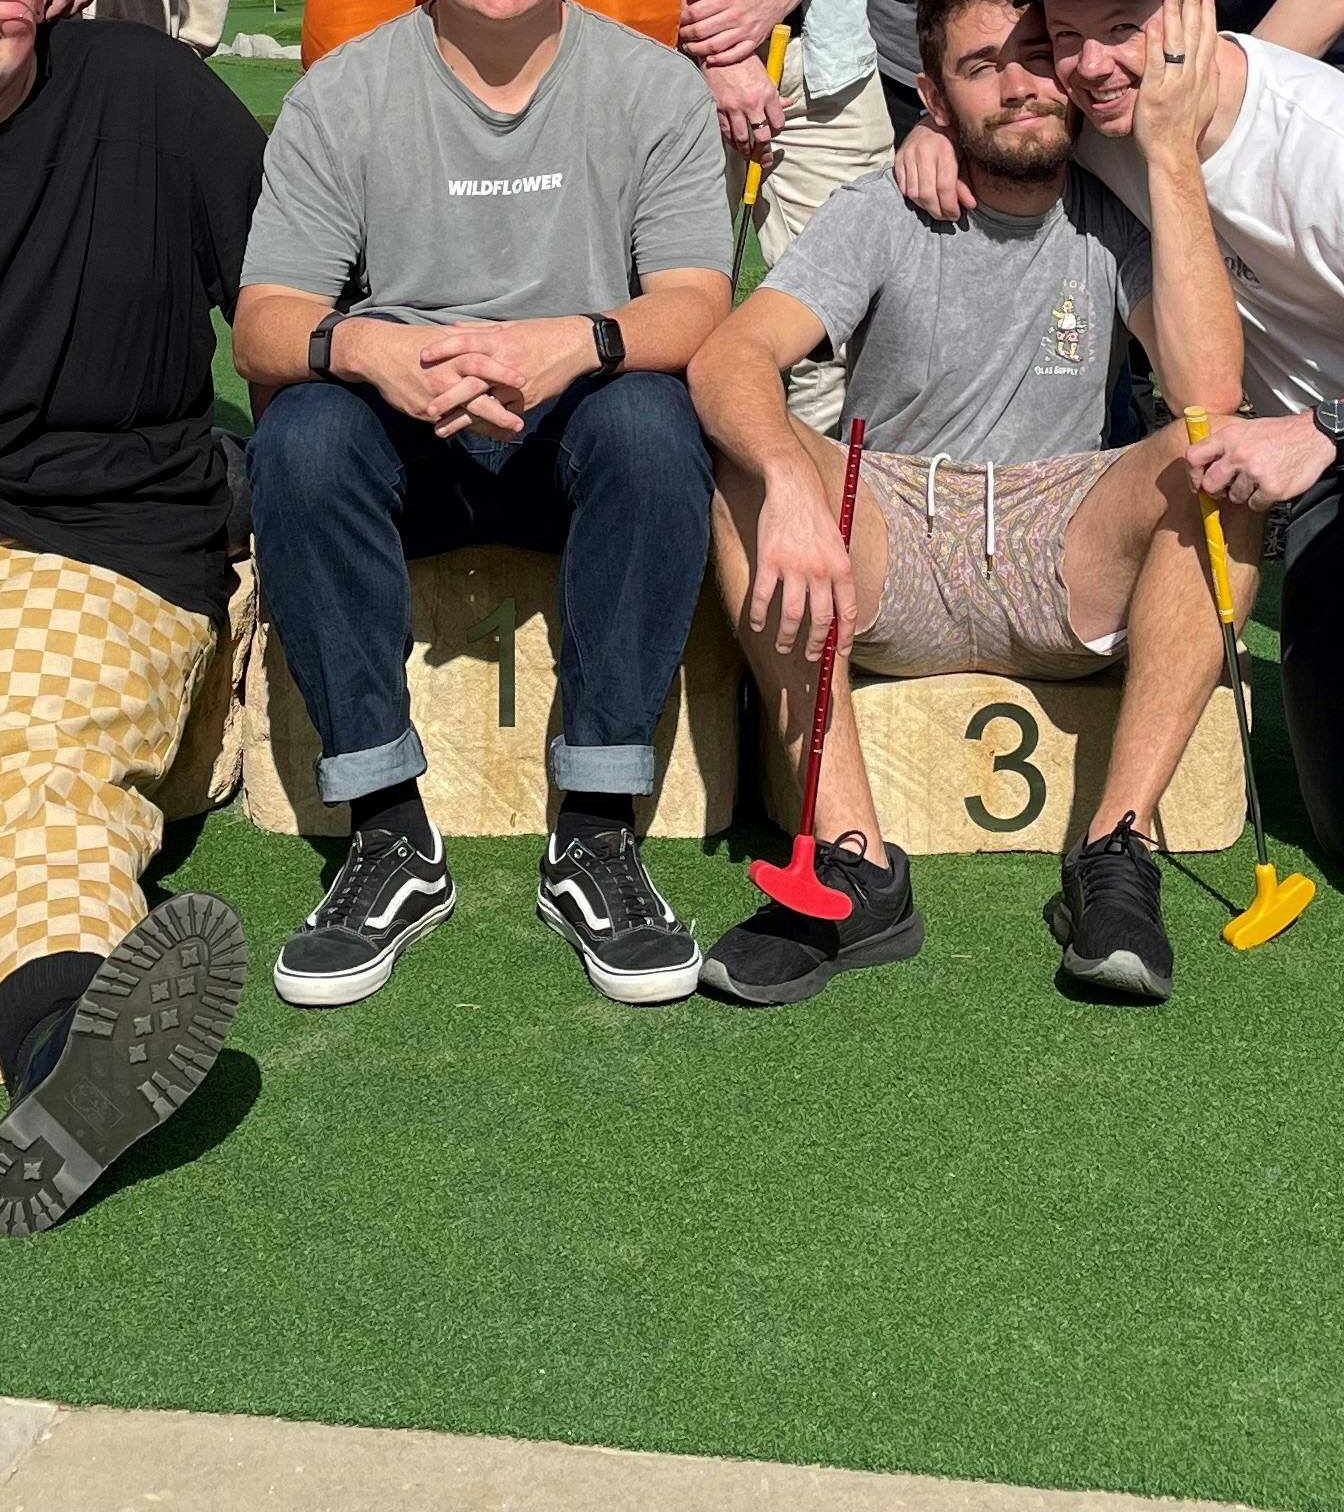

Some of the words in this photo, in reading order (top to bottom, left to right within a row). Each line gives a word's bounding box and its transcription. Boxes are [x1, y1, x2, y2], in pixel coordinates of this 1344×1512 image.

[448, 172, 564, 196] WILDFLOWER
[467, 598, 516, 727] 1
[964, 702, 1047, 833] 3
